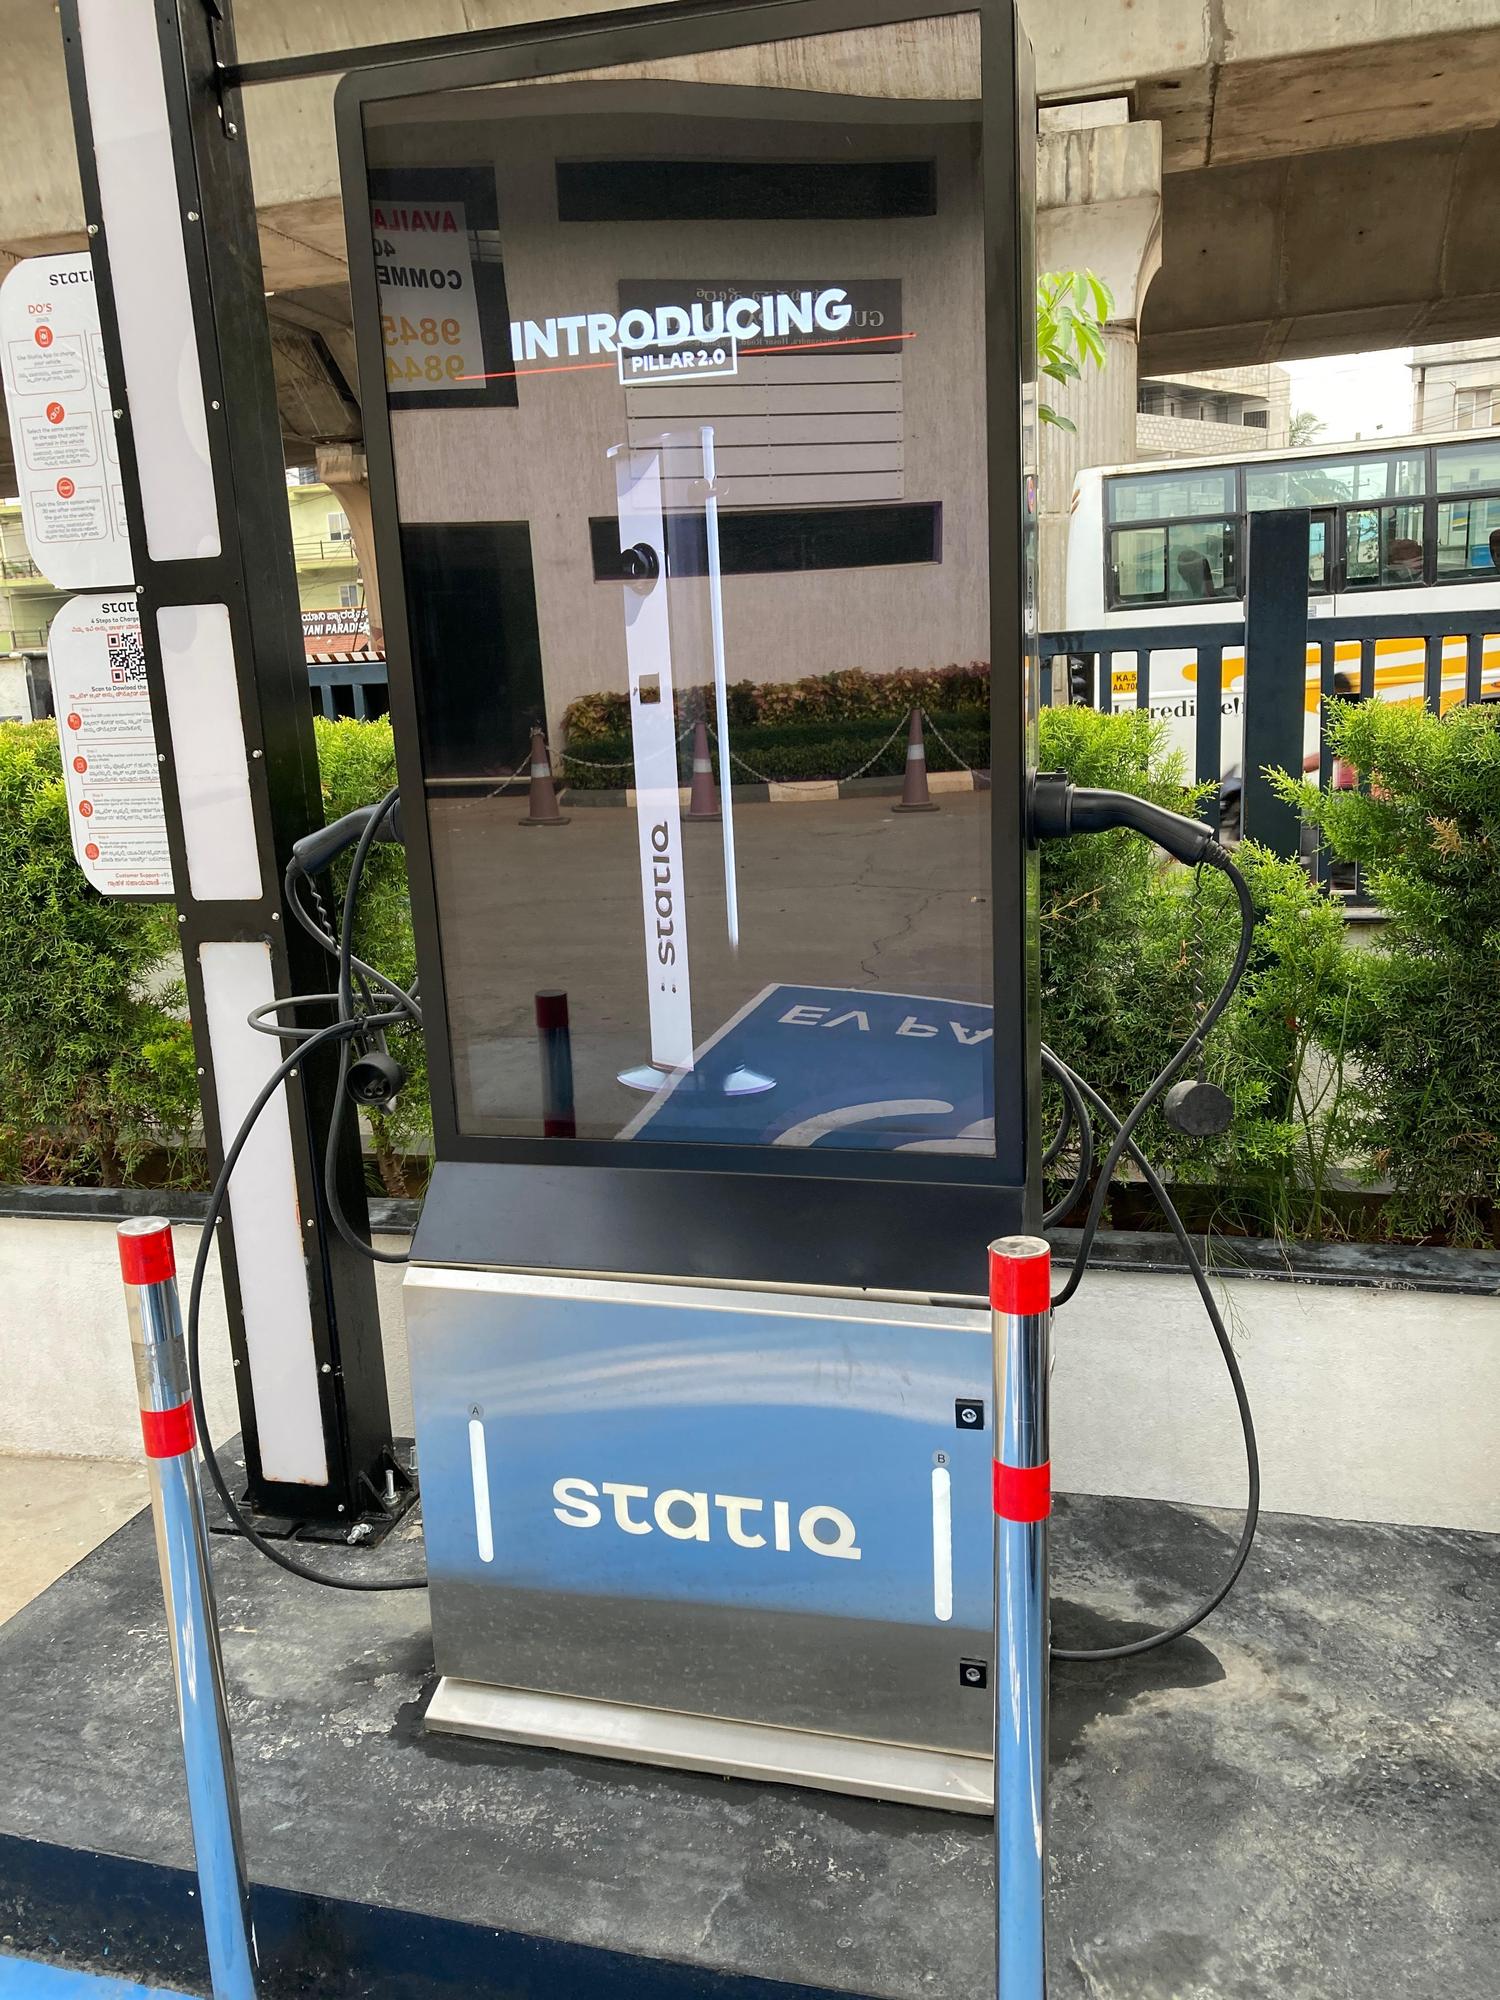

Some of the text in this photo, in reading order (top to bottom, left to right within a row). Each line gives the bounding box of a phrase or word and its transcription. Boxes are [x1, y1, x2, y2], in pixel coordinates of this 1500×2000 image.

[28, 303, 52, 314] DO'S
[510, 288, 852, 361] INTRODUCING
[632, 348, 726, 373] PILLAR 2.0
[1112, 682, 1138, 691] AA.70
[472, 1406, 480, 1414] A
[938, 1454, 946, 1463] B
